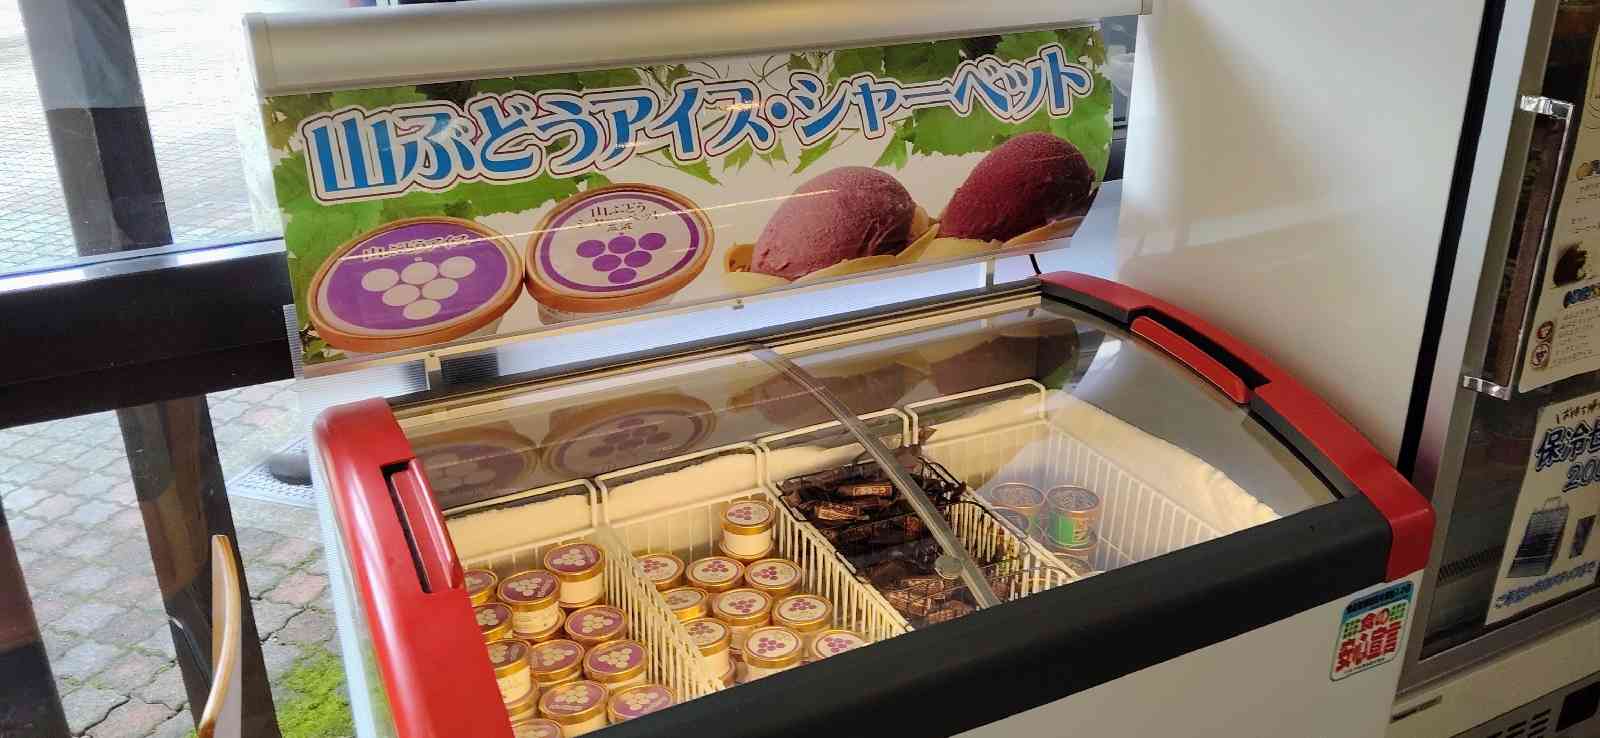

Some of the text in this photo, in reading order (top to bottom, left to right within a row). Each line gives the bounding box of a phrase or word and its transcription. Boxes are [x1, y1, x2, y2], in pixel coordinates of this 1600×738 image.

[309, 47, 1090, 200] 山ぶどうアイス・シャーベット
